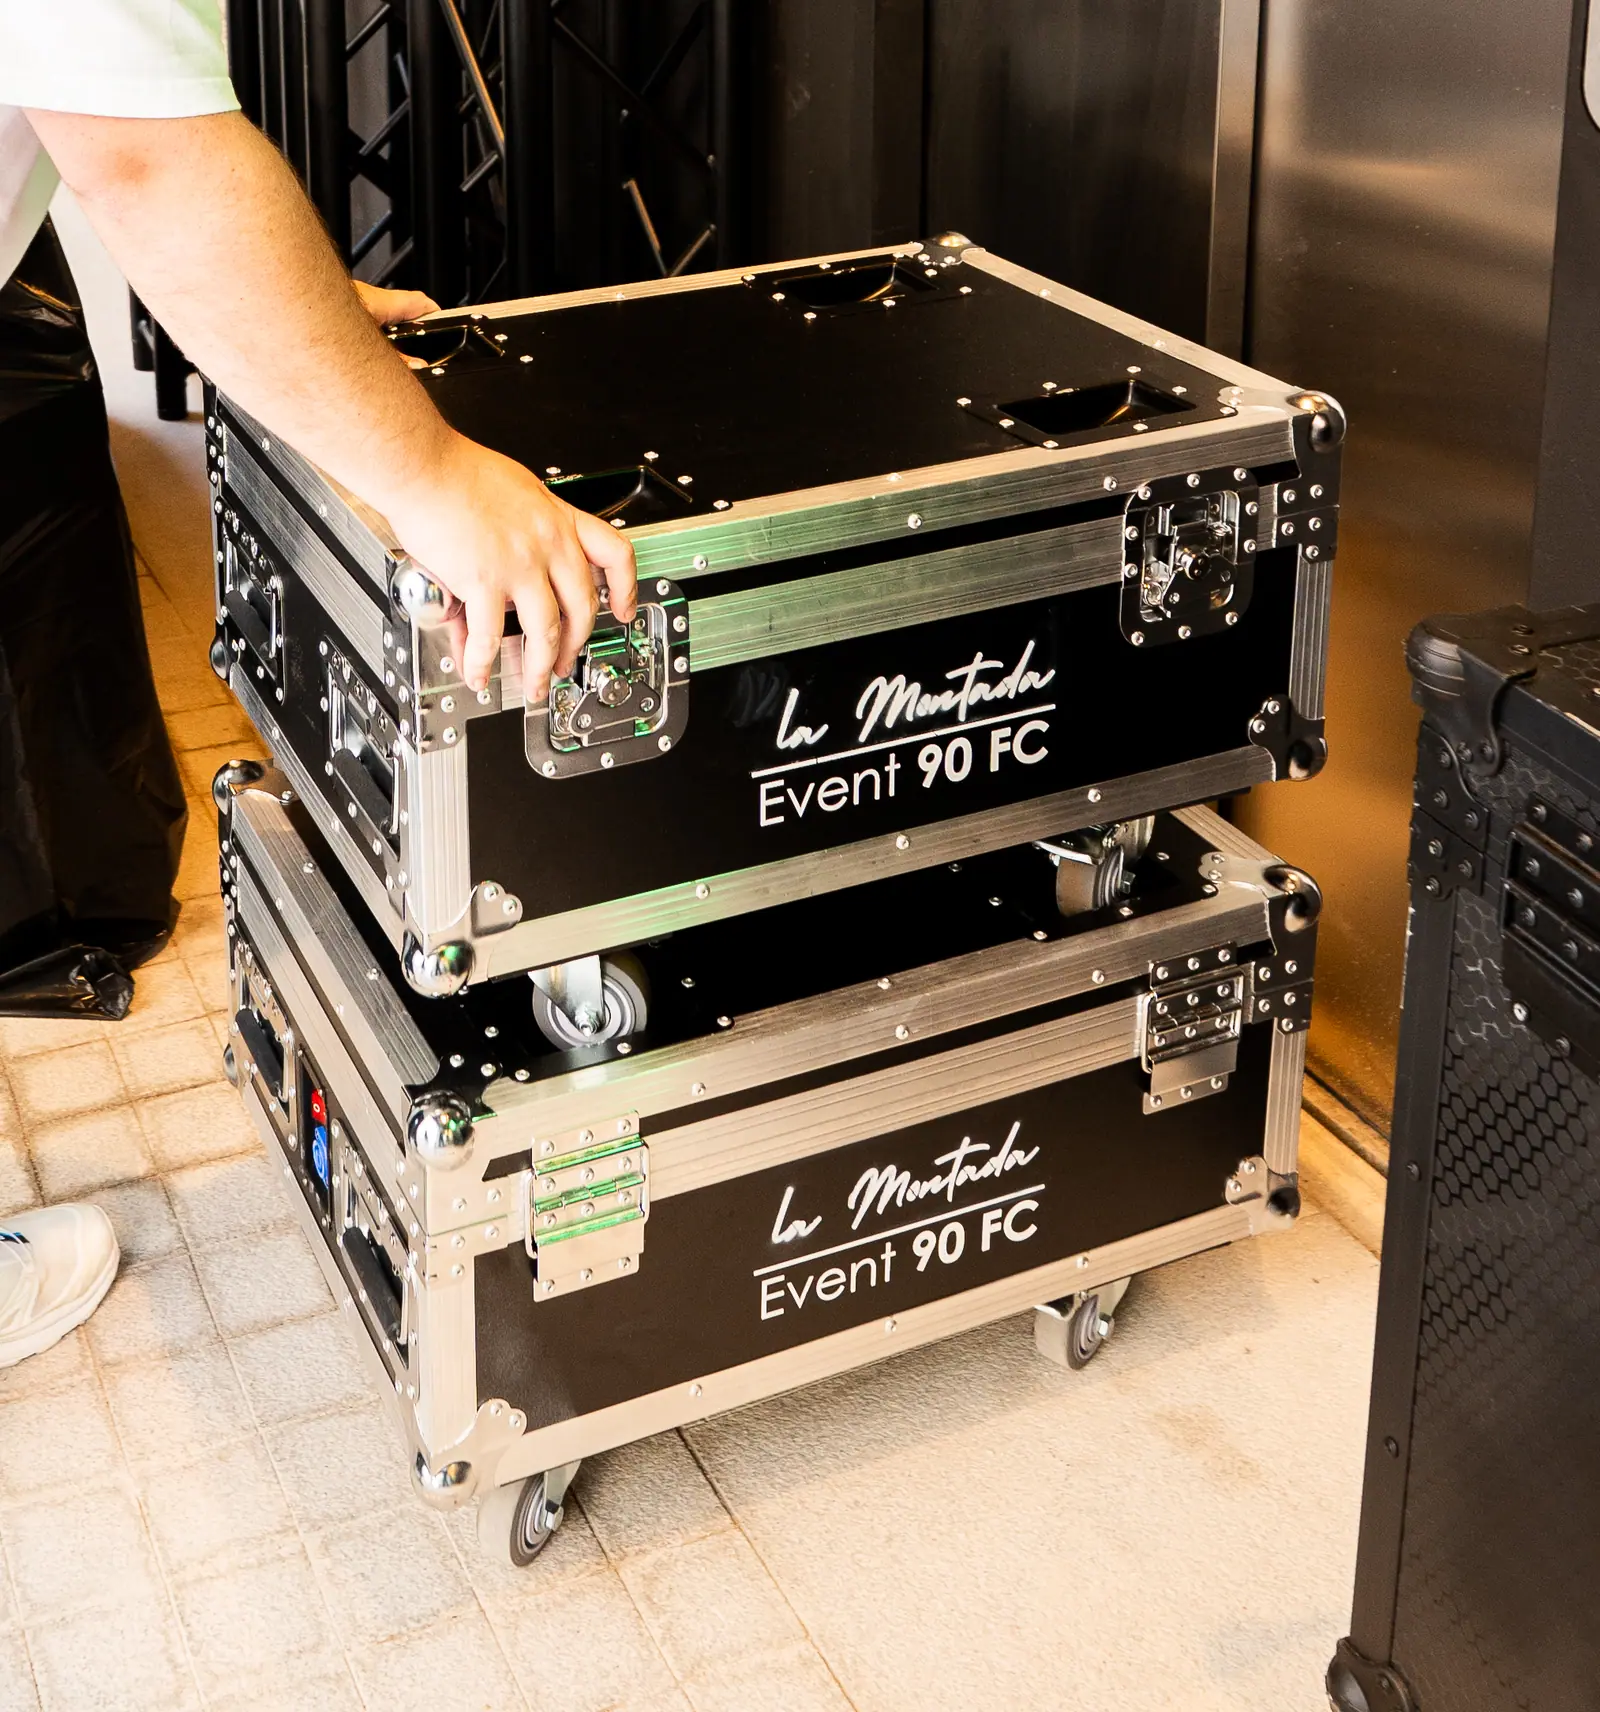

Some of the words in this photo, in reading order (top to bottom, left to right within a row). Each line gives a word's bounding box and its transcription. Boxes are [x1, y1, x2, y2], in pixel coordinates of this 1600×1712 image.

[759, 753, 901, 827] Event
[917, 736, 973, 788] 90
[989, 719, 1050, 773] FC
[760, 1242, 897, 1321] Event
[912, 1221, 966, 1273] 90
[980, 1199, 1040, 1253] FC
